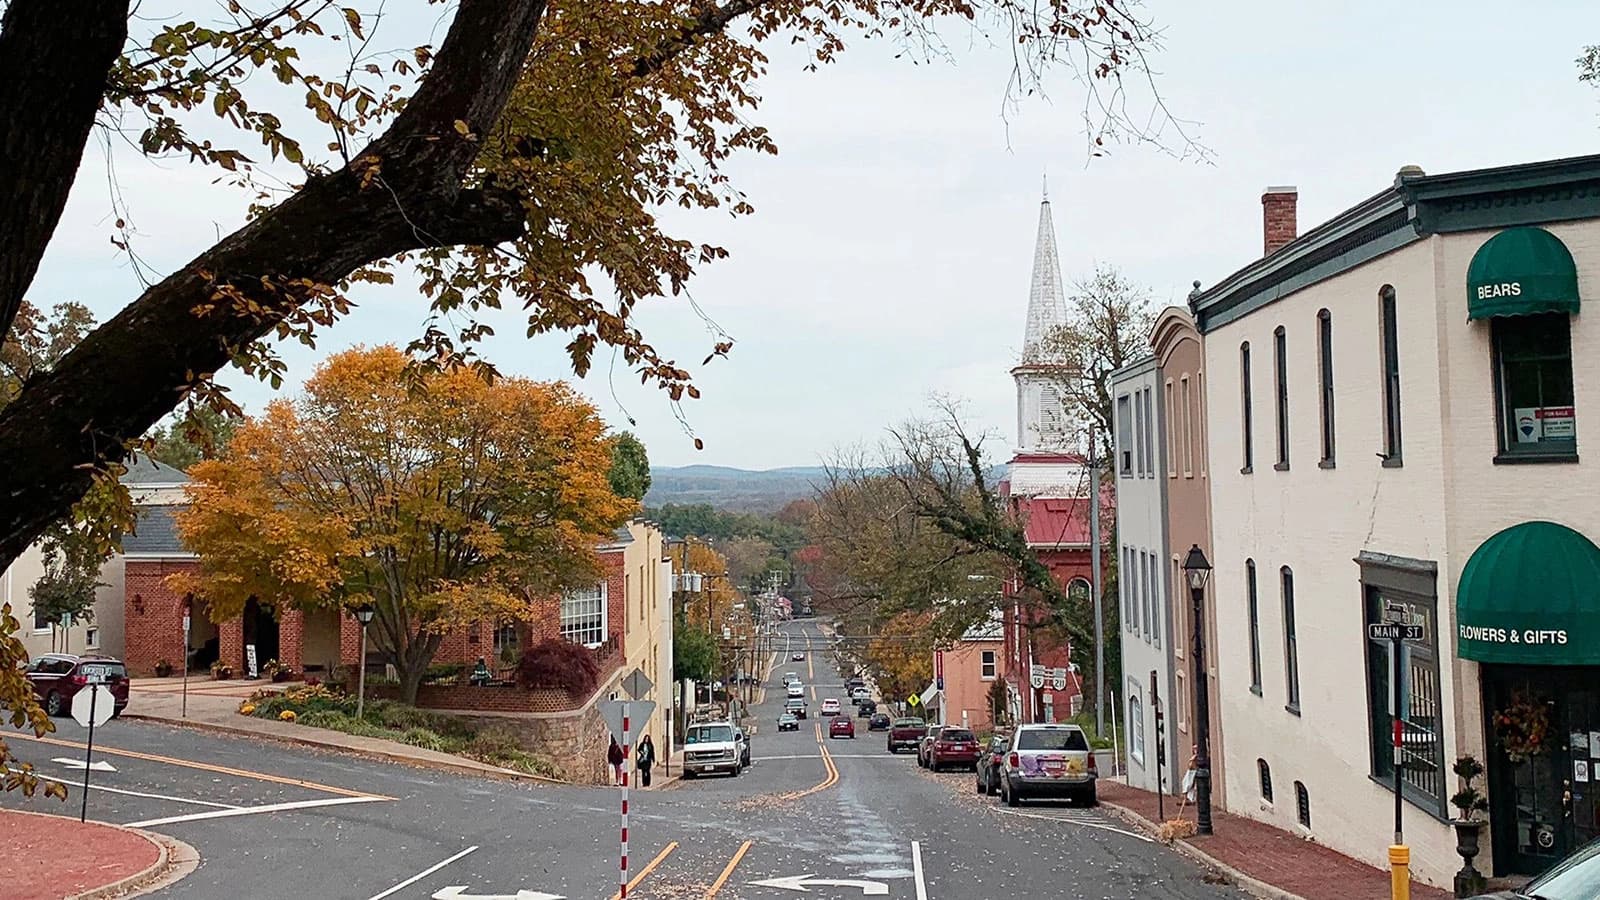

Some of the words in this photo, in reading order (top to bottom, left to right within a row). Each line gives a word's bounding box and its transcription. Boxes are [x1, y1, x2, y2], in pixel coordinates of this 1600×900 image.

[1477, 282, 1521, 299] BEARS
[1374, 626, 1399, 638] MAIN
[1406, 626, 1419, 638] ST
[1460, 624, 1506, 643] FLOWERS
[1510, 629, 1520, 643] &
[1523, 630, 1568, 644] GIFTS
[1033, 677, 1042, 686] 15
[1055, 679, 1065, 687] 211
